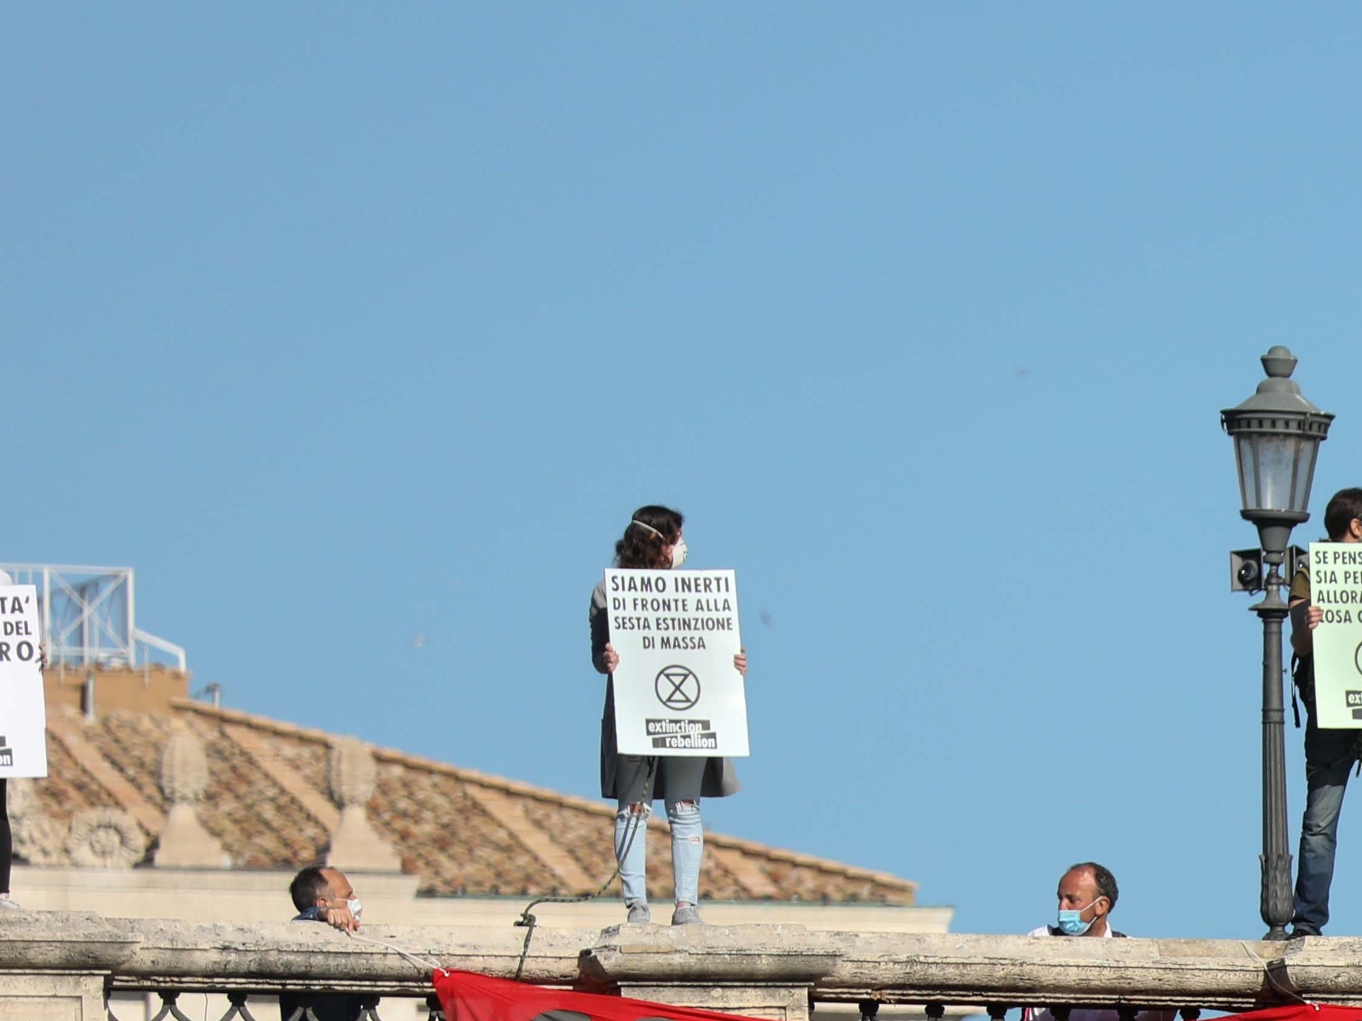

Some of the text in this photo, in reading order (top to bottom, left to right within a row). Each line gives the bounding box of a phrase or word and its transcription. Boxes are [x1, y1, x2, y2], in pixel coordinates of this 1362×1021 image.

[1315, 551, 1328, 564] SE
[611, 575, 729, 593] SIAMO INERTI
[1316, 571, 1337, 584] SIA
[613, 597, 731, 612] DI FRONTE ALLA
[4, 621, 32, 636] DEL
[614, 616, 733, 630] SESTA ESTINZIONE
[643, 636, 706, 649] DI MASSA
[648, 720, 702, 733] extinction
[666, 732, 715, 748] rebellion
